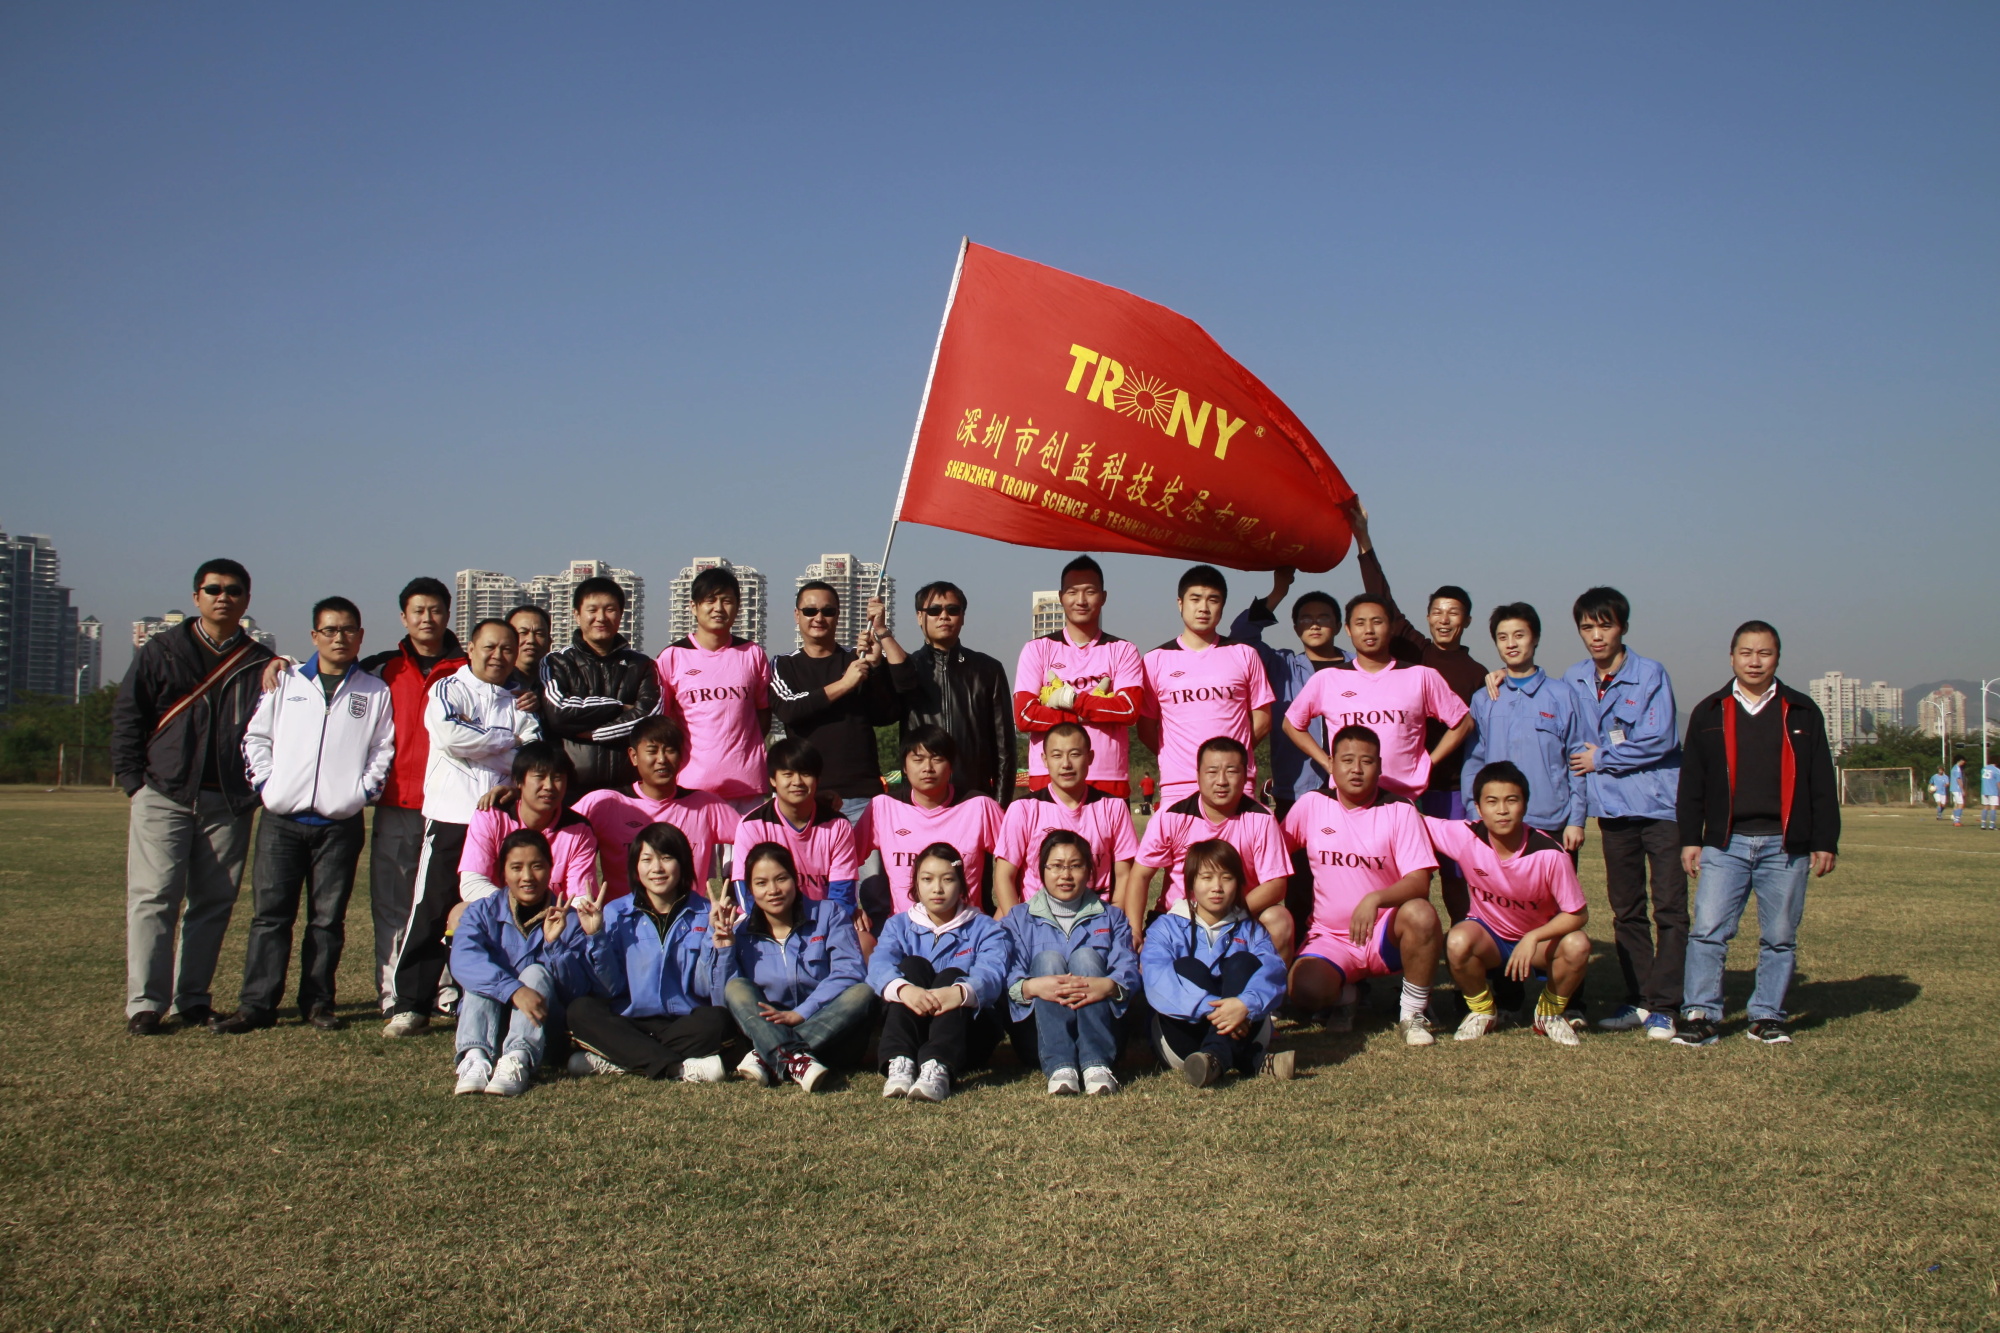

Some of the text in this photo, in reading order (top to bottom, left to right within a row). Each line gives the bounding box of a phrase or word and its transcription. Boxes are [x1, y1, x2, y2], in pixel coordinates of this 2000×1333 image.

[944, 460, 998, 489] SHENZHEN
[1000, 474, 1039, 503] TRONY
[1041, 489, 1089, 520] SCIENCE
[1090, 508, 1101, 523] &
[685, 685, 752, 704] TRONY
[1169, 685, 1239, 705] TRONY
[1340, 709, 1409, 726] TRONY
[1318, 850, 1388, 871] TRONY
[1469, 884, 1544, 911] TRONY
